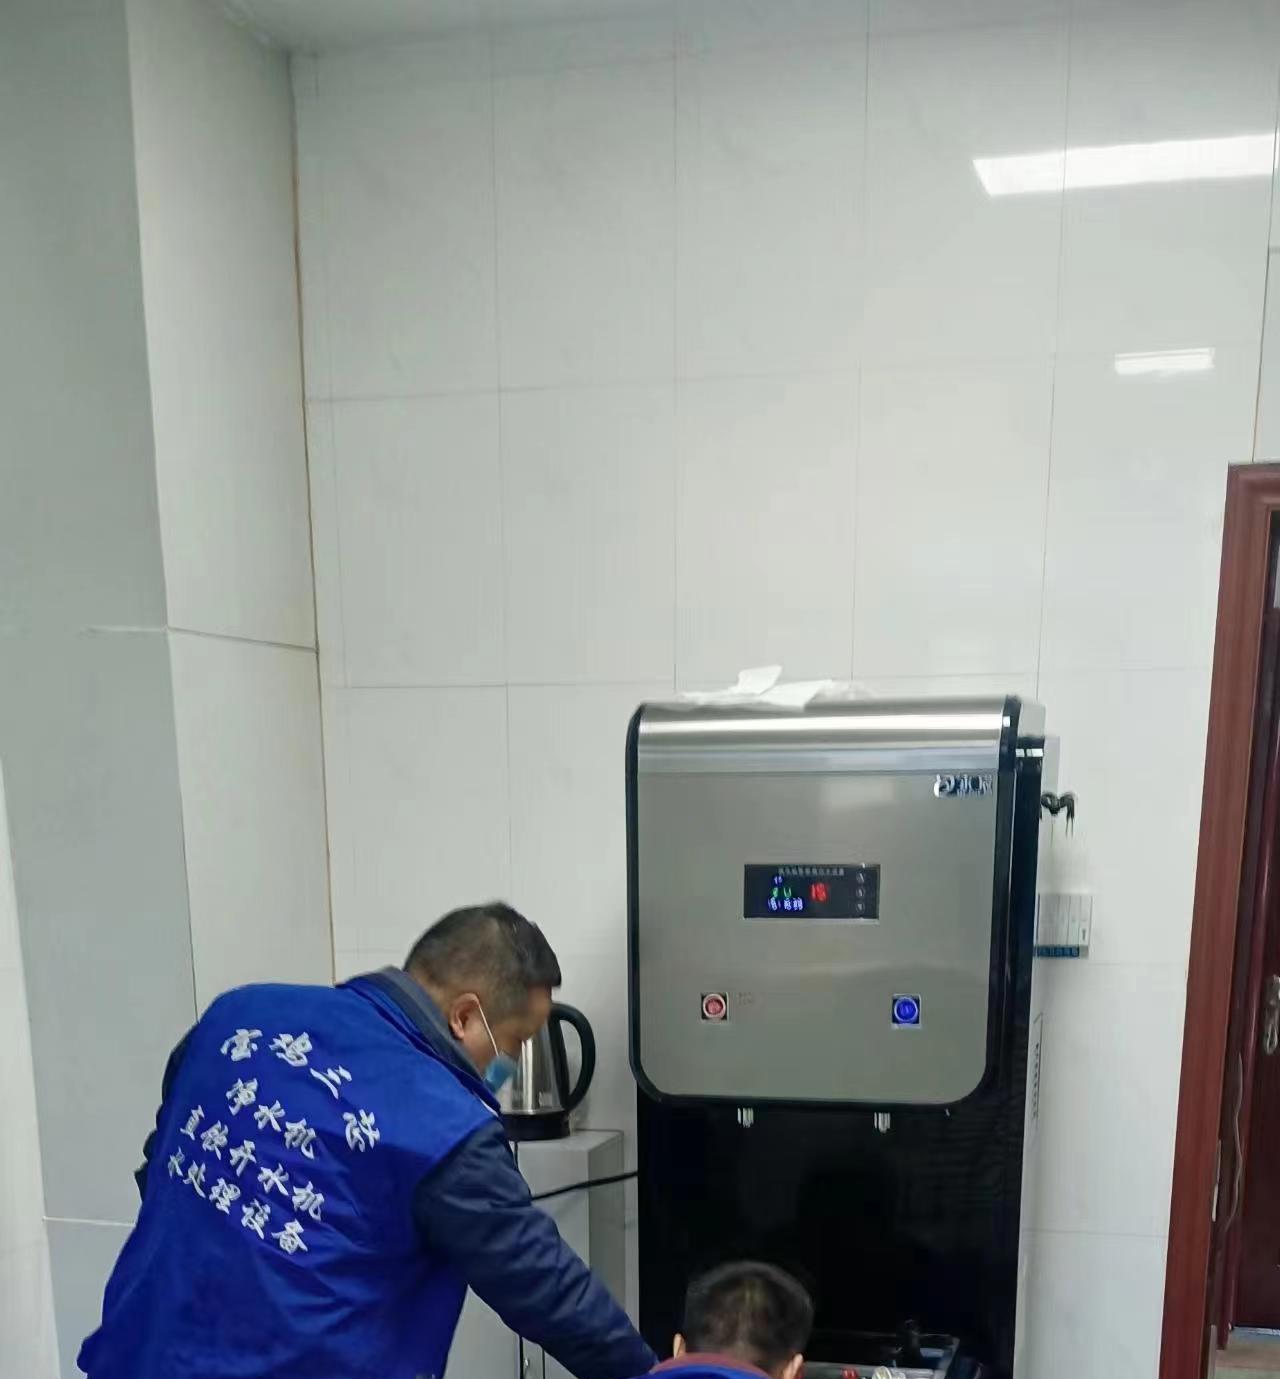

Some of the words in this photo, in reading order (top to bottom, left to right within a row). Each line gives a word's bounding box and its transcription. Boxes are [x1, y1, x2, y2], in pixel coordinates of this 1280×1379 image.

[180, 1104, 325, 1222] 直饮开水机
[226, 1078, 317, 1160] 净水机
[168, 1146, 308, 1255] 水处理设备
